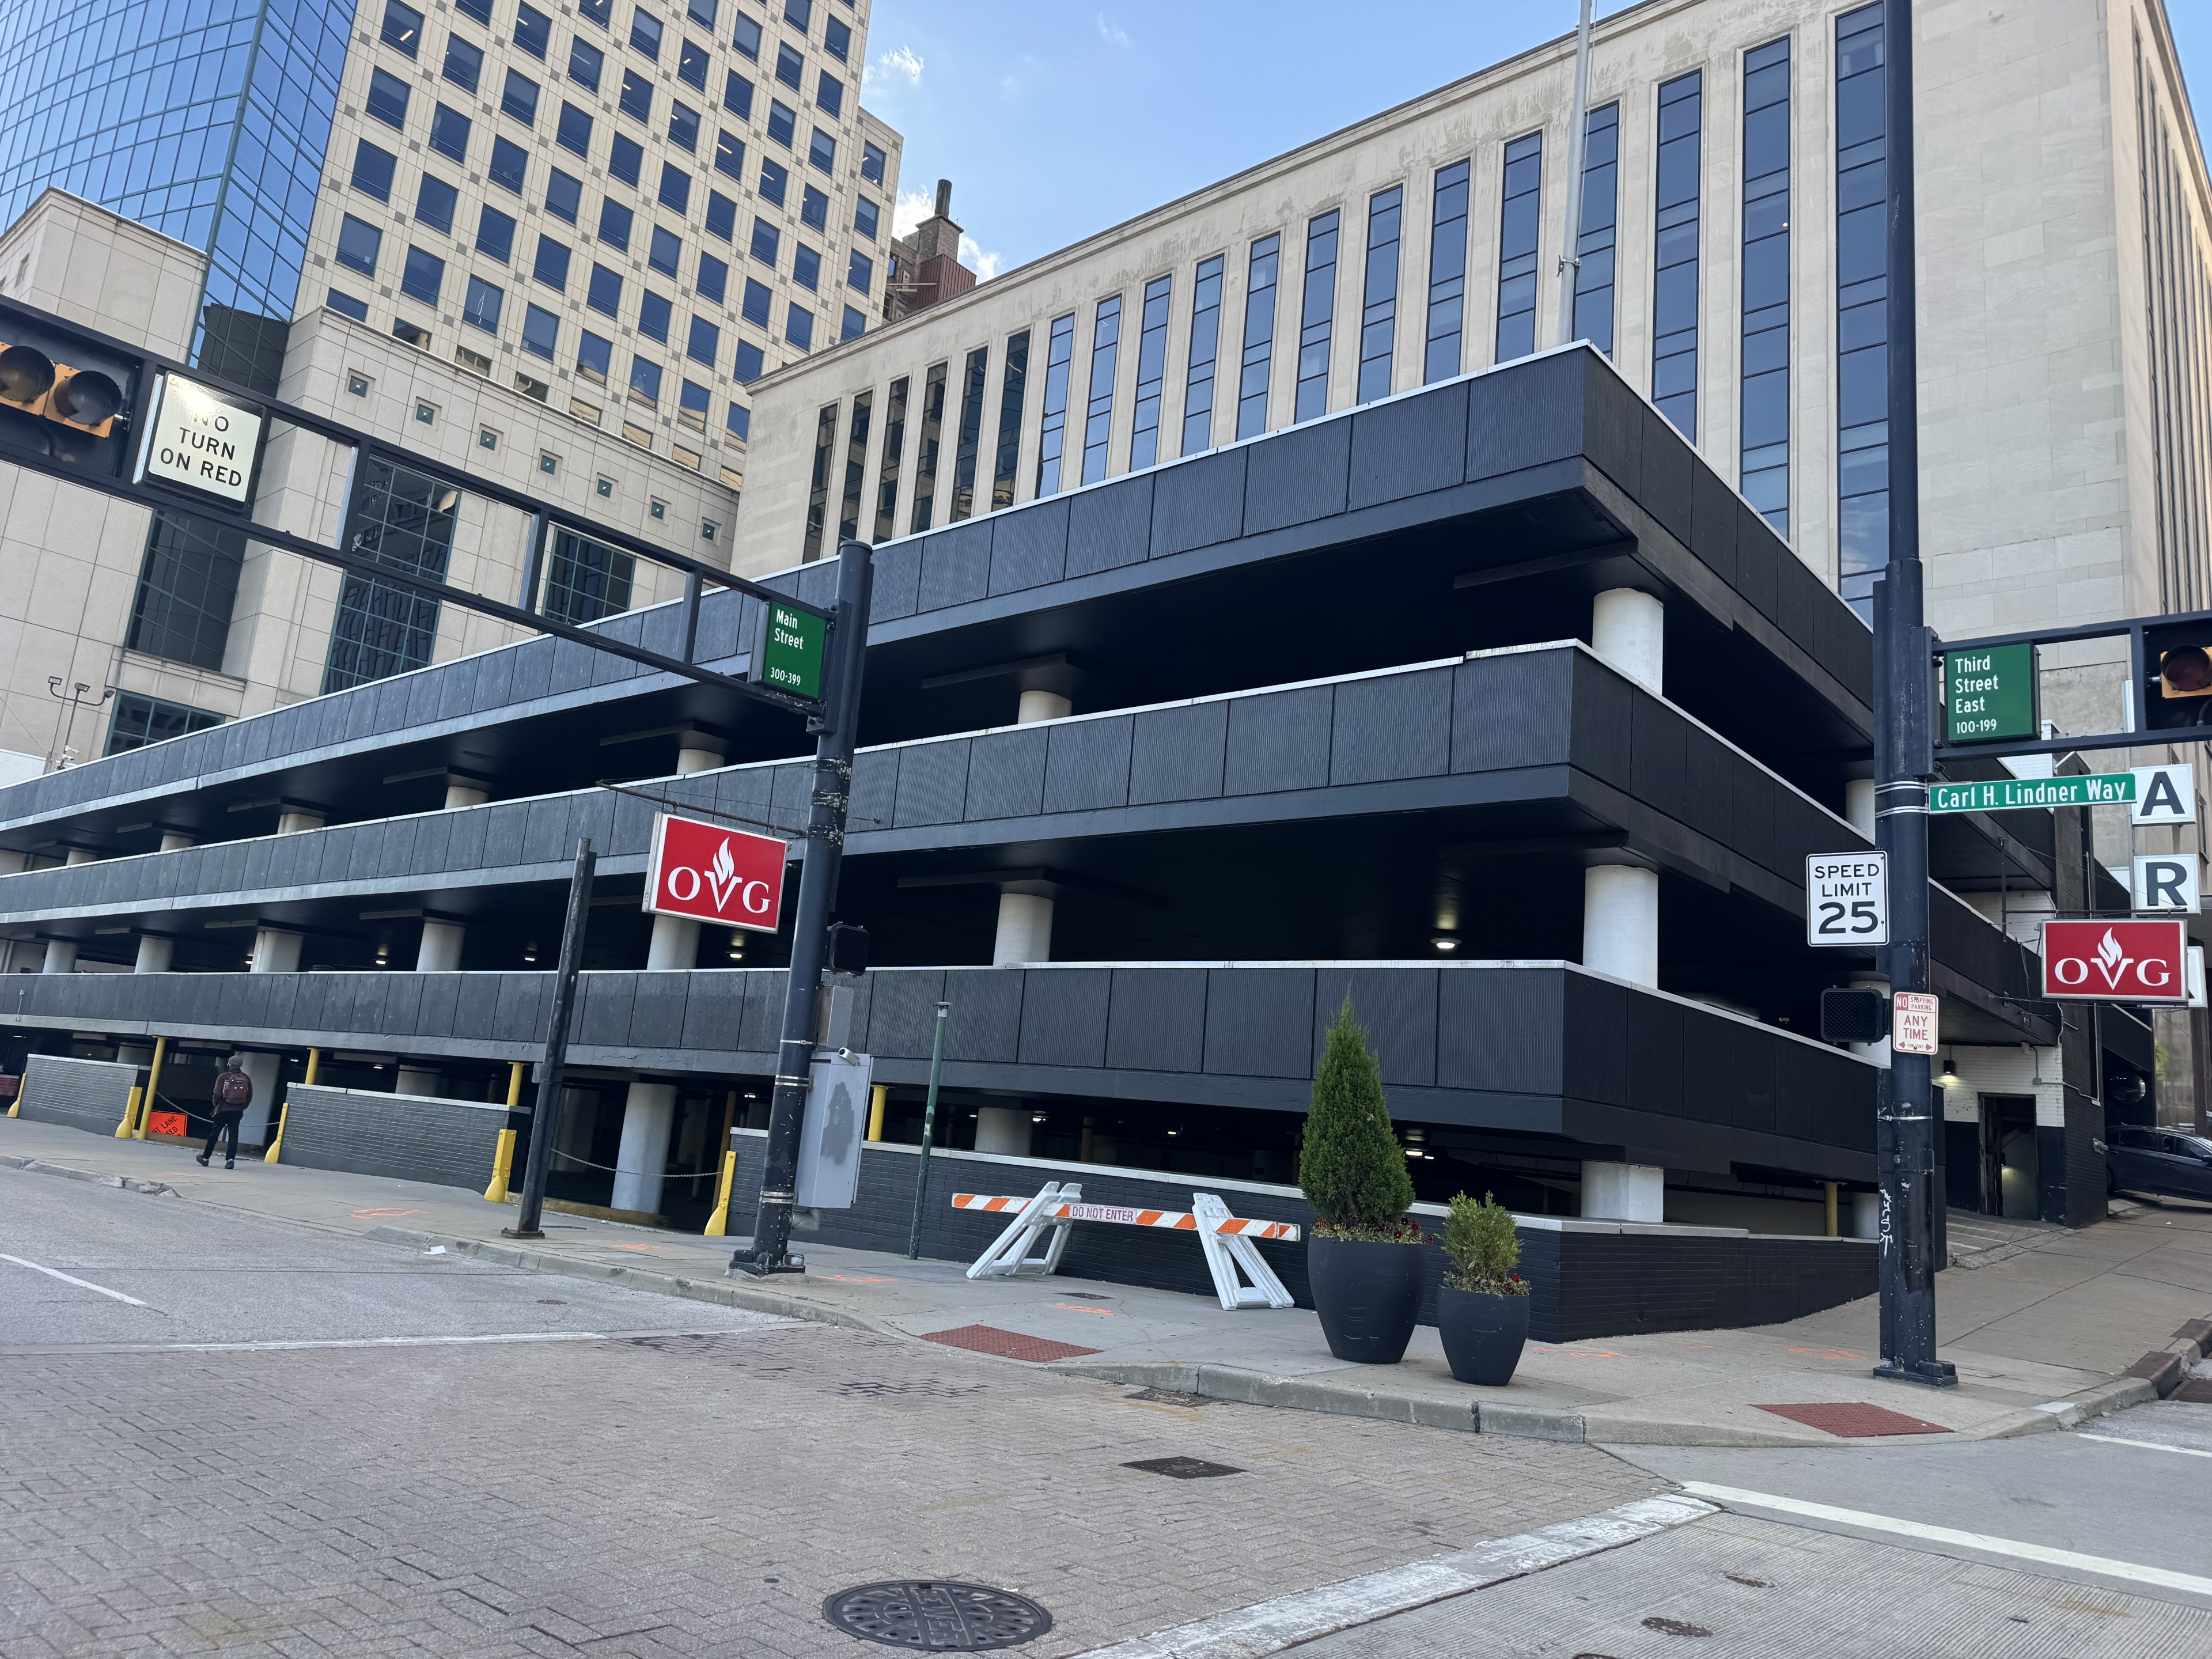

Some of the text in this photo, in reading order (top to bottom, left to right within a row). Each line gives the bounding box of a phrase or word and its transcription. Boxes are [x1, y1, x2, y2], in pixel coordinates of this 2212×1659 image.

[179, 427, 236, 460] TURN
[160, 448, 242, 487] ON RED
[776, 609, 798, 629] Main
[774, 628, 804, 650] Street
[1955, 655, 1990, 673] Third
[770, 667, 801, 686] 300-399
[1955, 675, 1999, 694] Street
[1956, 696, 1985, 714] East
[1956, 719, 1997, 734] 100-199
[1938, 779, 2126, 808] Carl H. Lindner Way
[1815, 863, 1880, 879] SPEED
[668, 866, 771, 913] OVG
[1822, 882, 1872, 897] LIMIT
[1819, 901, 1878, 934] 25
[2055, 957, 2172, 991] OVG
[1896, 997, 1908, 1008] NO
[1904, 1014, 1927, 1027] ANY
[1903, 1028, 1928, 1040] TIME
[161, 1115, 178, 1129] LANE
[1072, 1206, 1134, 1222] DO NOT ENTER
